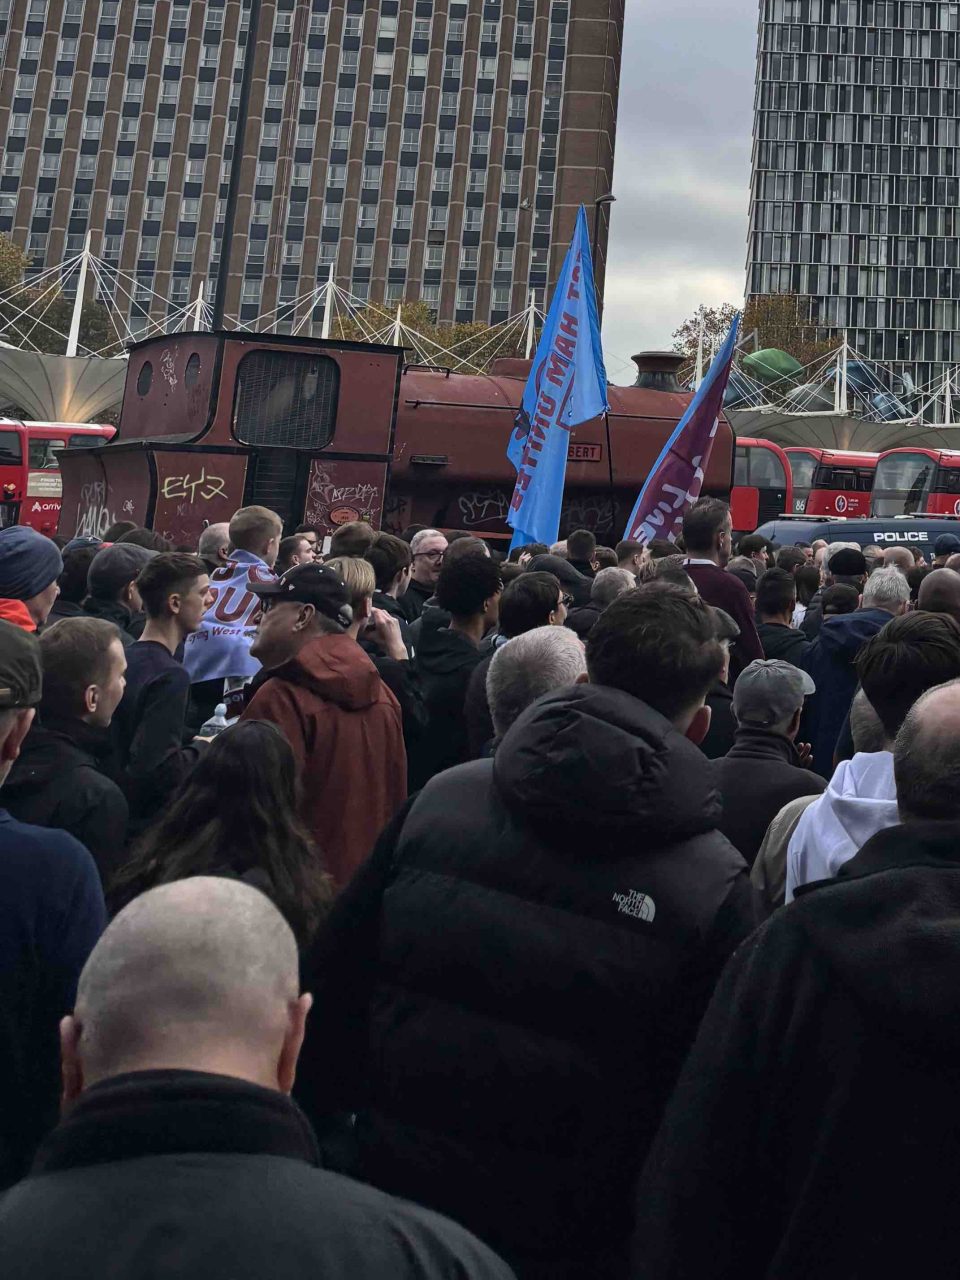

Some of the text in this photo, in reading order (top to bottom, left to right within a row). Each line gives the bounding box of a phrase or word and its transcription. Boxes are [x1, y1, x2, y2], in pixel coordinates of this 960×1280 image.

[568, 446, 596, 458] BERT
[42, 503, 62, 512] arriv
[795, 499, 806, 511] 86
[873, 531, 929, 543] POLICE
[212, 627, 241, 636] West
[612, 892, 643, 910] NORTH
[629, 889, 646, 901] THE
[618, 902, 641, 919] FACE
